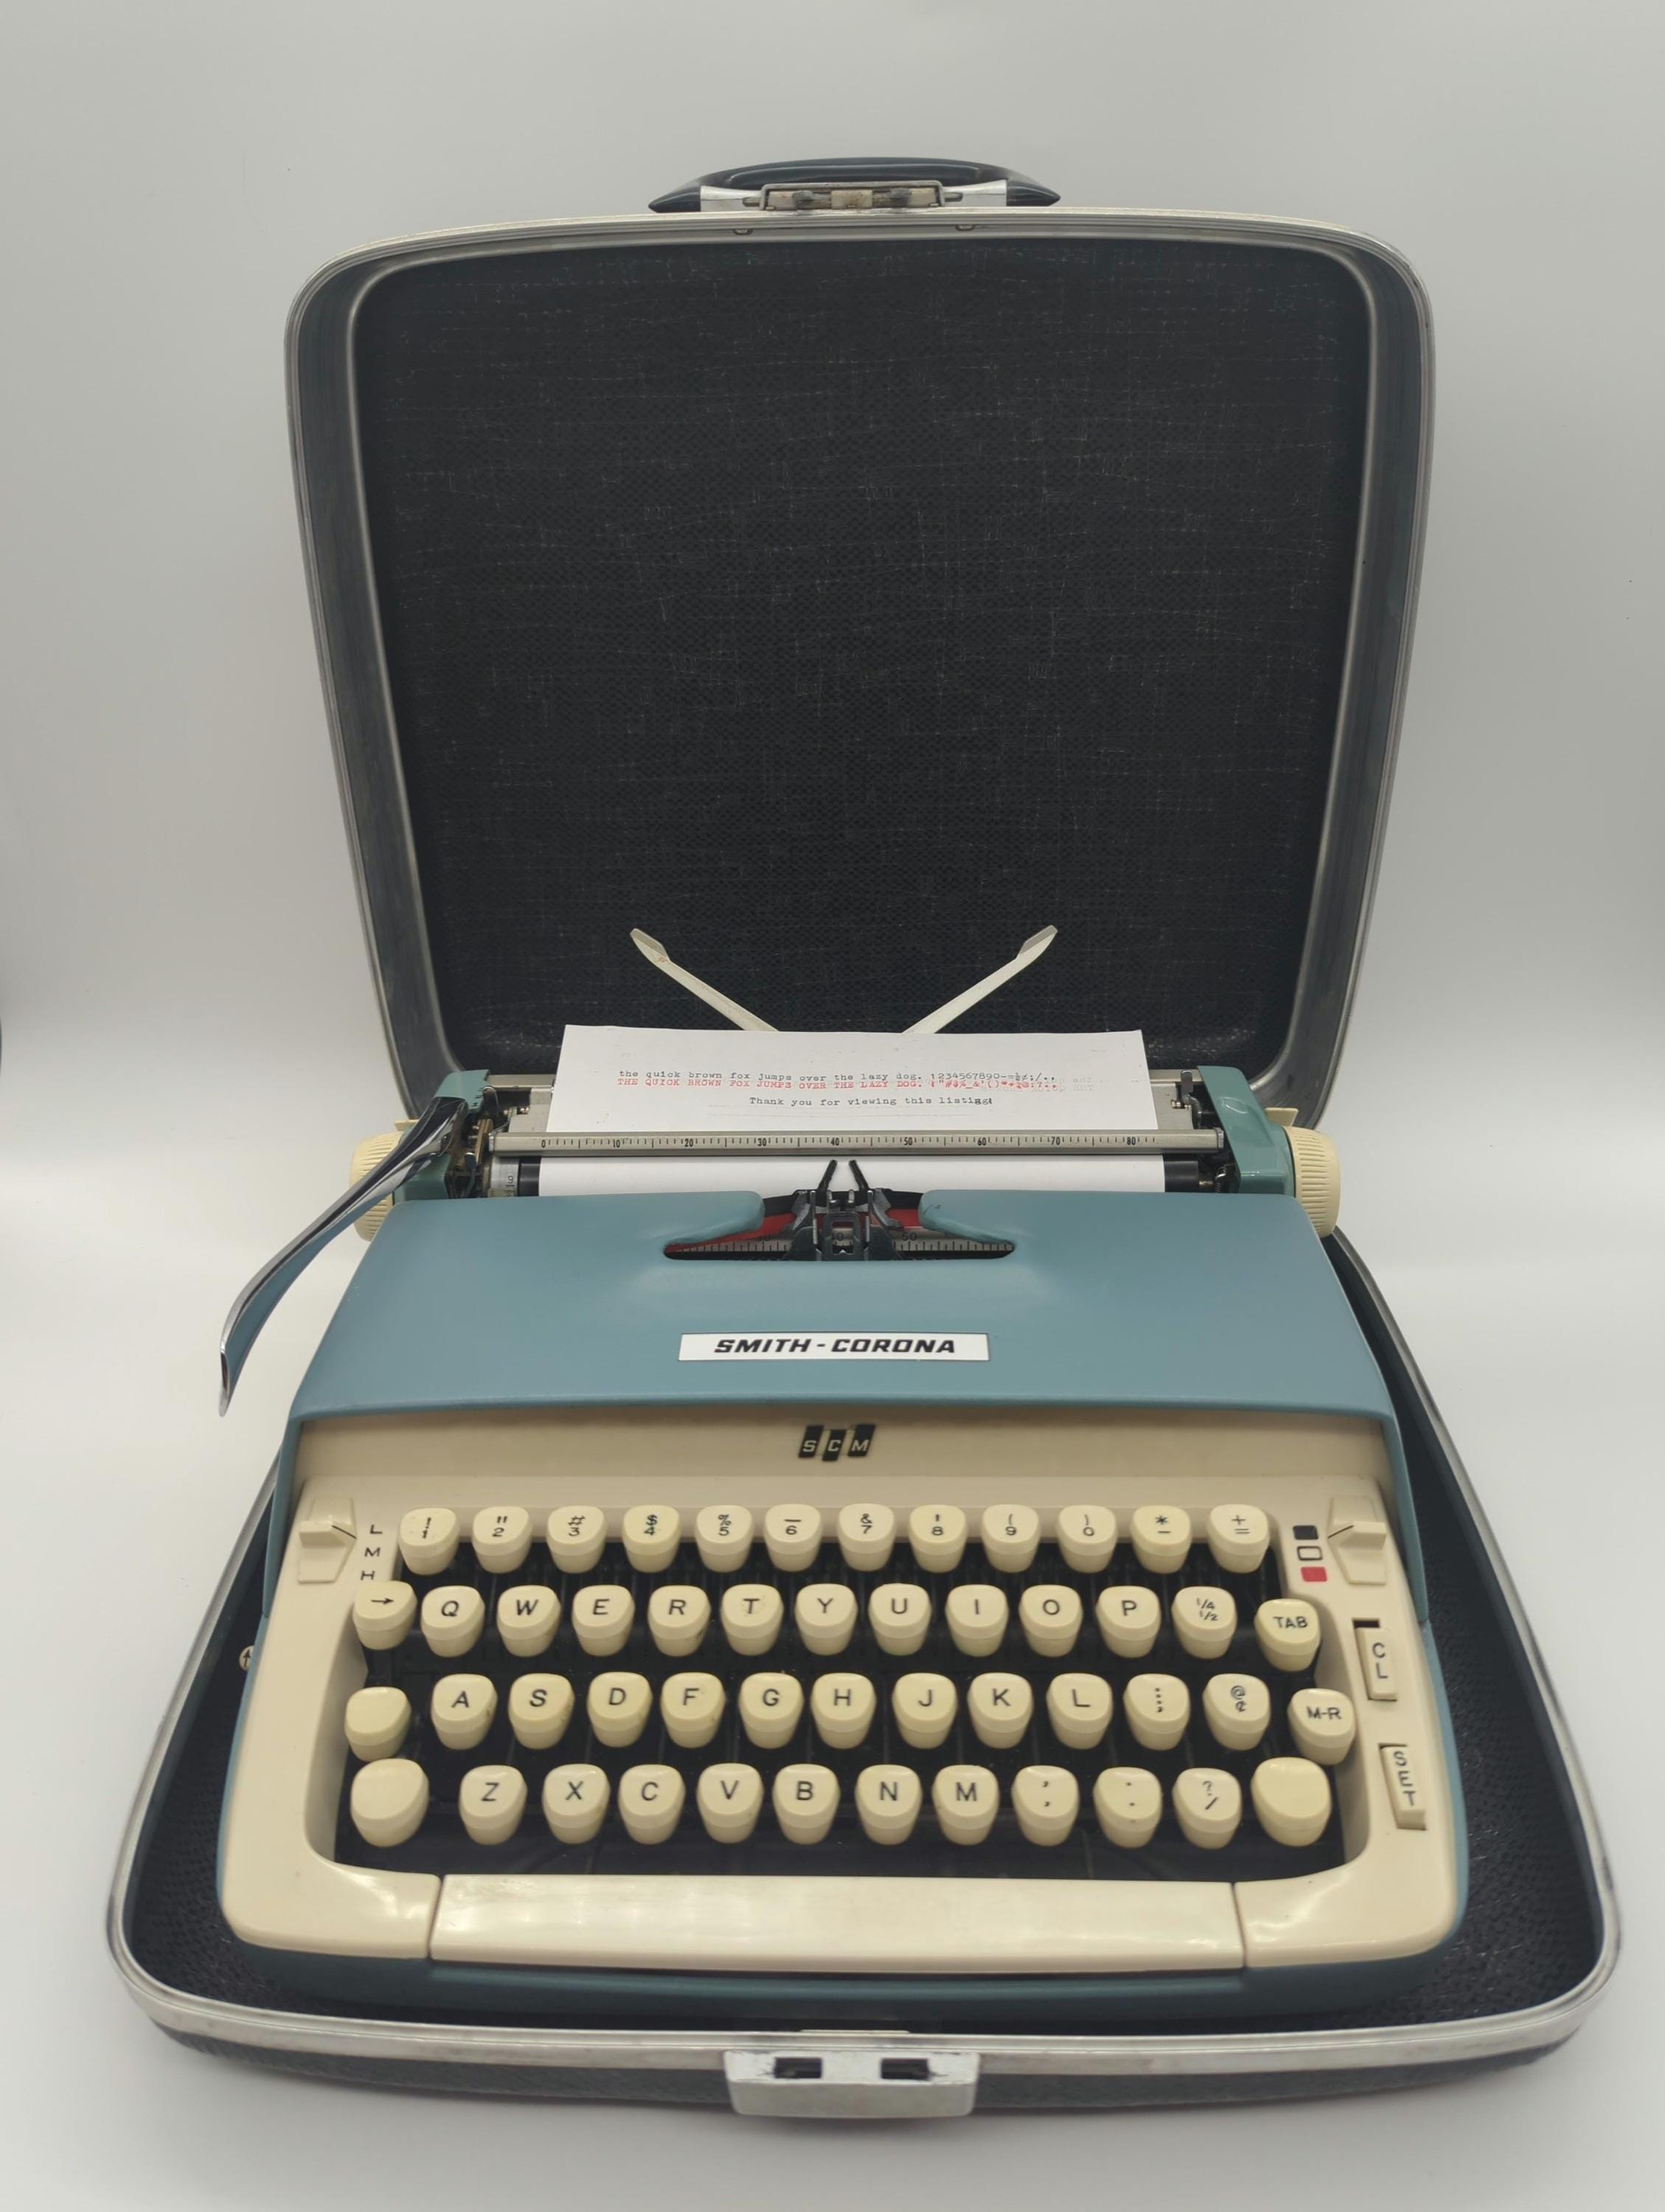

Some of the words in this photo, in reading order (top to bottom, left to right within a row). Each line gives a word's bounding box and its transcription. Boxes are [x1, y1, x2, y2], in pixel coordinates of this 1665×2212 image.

[758, 1073, 792, 1081] jumps
[861, 1073, 889, 1081] lazy
[896, 1073, 922, 1081] dog.
[749, 1097, 785, 1105] Thank
[848, 1097, 897, 1105] viewing
[541, 1139, 546, 1149] 0
[613, 1139, 621, 1149] 10
[684, 1138, 695, 1148] 20
[757, 1138, 767, 1147] 30
[830, 1137, 840, 1147] 40
[904, 1136, 914, 1146] 50
[977, 1136, 987, 1146] 60
[1051, 1136, 1060, 1146] 70
[1127, 1136, 1136, 1146] 80
[802, 1438, 871, 1453] SCM
[567, 1516, 585, 1526] #
[646, 1514, 658, 1526] $
[718, 1514, 731, 1526] %
[861, 1513, 873, 1525] &
[370, 1525, 383, 1534] L
[492, 1528, 504, 1537] 2
[569, 1527, 580, 1537] 3
[643, 1526, 656, 1536] 4
[719, 1526, 729, 1537] 5
[786, 1525, 797, 1535] 6
[861, 1525, 872, 1535] 7
[931, 1526, 944, 1537] 8
[1005, 1526, 1017, 1536] 9
[364, 1547, 380, 1557] M
[361, 1570, 375, 1580] H
[440, 1600, 460, 1618] Q
[516, 1599, 538, 1615] W
[592, 1599, 610, 1615] E
[668, 1599, 686, 1615] R
[743, 1598, 760, 1615] T
[818, 1598, 833, 1614] Y
[891, 1598, 908, 1614] U
[1043, 1599, 1060, 1615] O
[1122, 1600, 1136, 1615] P
[1273, 1615, 1308, 1630] TAB
[451, 1691, 470, 1708] A
[529, 1689, 549, 1708] S
[608, 1688, 626, 1706] D
[682, 1688, 699, 1705] F
[762, 1688, 779, 1707] G
[833, 1688, 852, 1706] H
[918, 1688, 933, 1707] J
[992, 1688, 1011, 1707] K
[1071, 1688, 1091, 1707] L
[1231, 1686, 1246, 1700] @
[1307, 1707, 1341, 1721] M-R
[1393, 1750, 1416, 1806] SET
[482, 1782, 499, 1801] Z
[566, 1781, 583, 1801] X
[641, 1781, 658, 1801] C
[720, 1780, 740, 1800] V
[796, 1781, 813, 1801] B
[880, 1781, 898, 1801] N
[956, 1781, 977, 1801] M
[1202, 1780, 1213, 1796] ?
